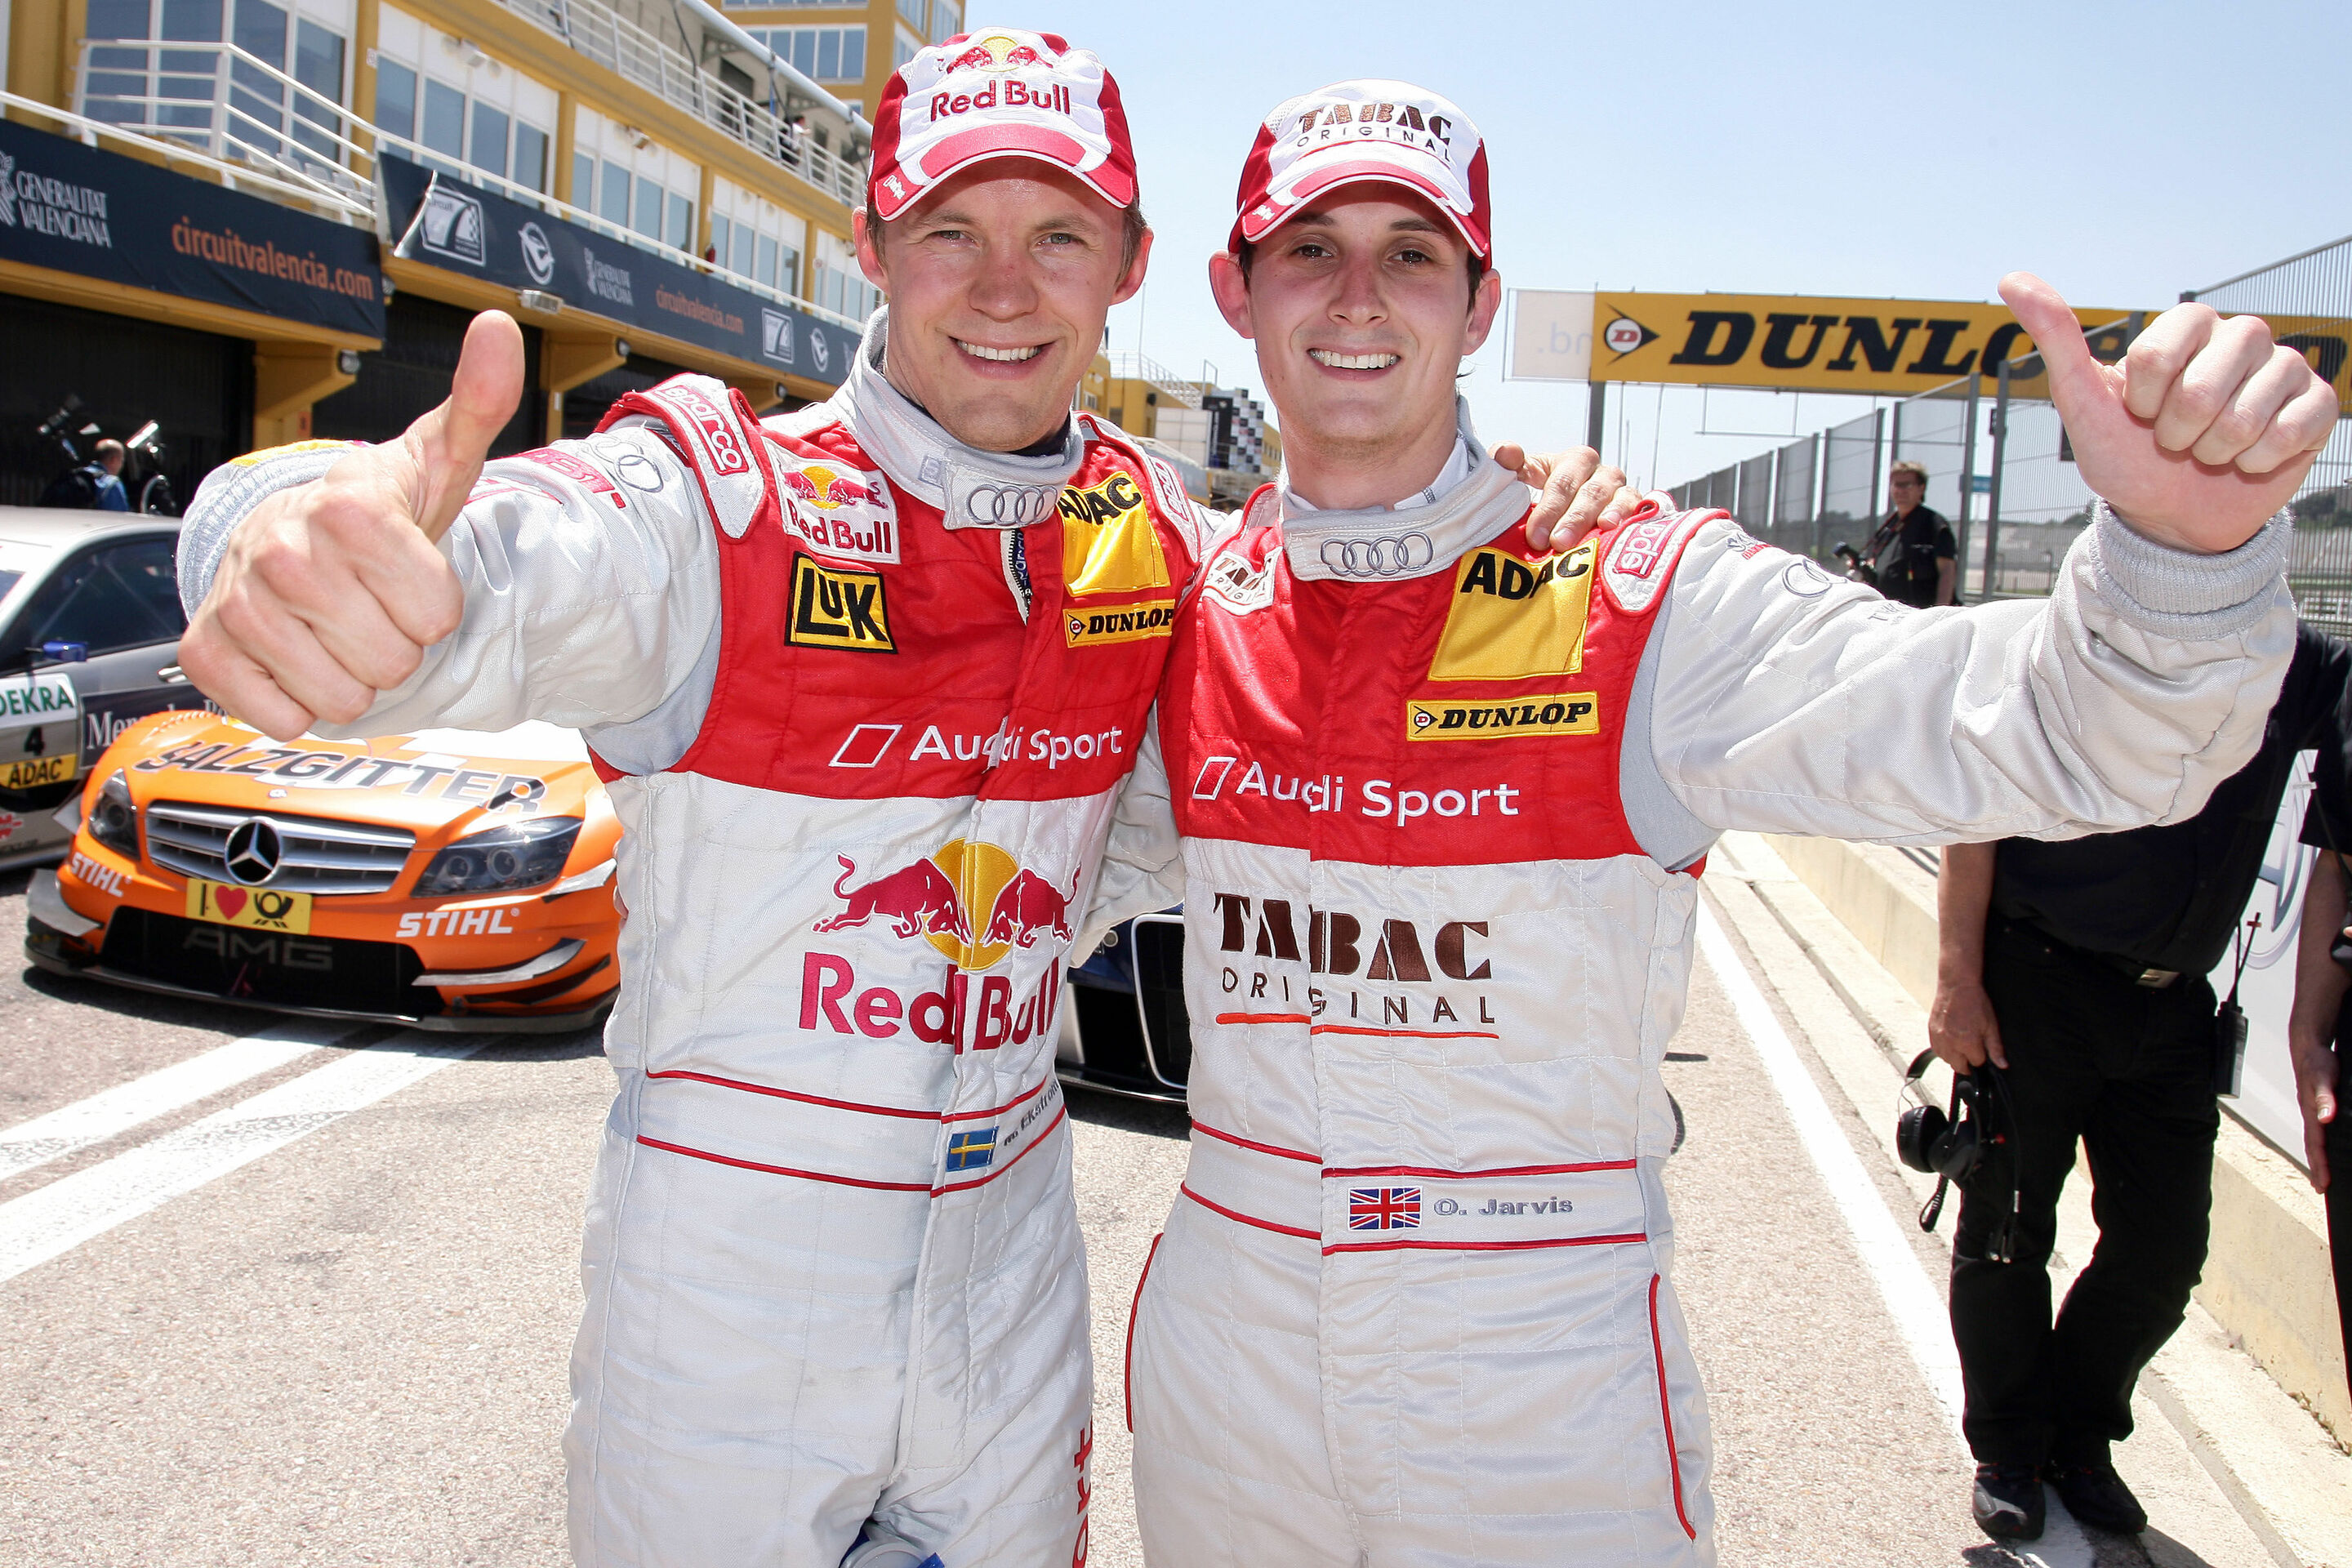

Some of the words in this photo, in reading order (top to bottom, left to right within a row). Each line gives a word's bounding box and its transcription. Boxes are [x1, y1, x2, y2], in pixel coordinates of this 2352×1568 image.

[930, 80, 996, 122] Red
[1004, 80, 1071, 115] Bull
[1298, 103, 1452, 146] TABAC
[1297, 127, 1450, 163] ORIGINAL
[16, 170, 107, 219] GENERALITAT
[19, 200, 112, 248] VALENCIANA
[172, 215, 374, 301] circuitvalencia.com
[1058, 477, 1142, 525] ADAC
[786, 499, 830, 546] Red
[831, 520, 892, 554] Bull
[1087, 608, 1174, 635] DUNLOP
[1438, 702, 1592, 730] DUNLOP
[24, 727, 45, 756] 4
[909, 716, 1025, 768] Audi
[1028, 726, 1122, 769] Sport
[7, 757, 63, 787] ADAC
[131, 740, 547, 813] SALZGITTER
[1236, 761, 1344, 813] Audi
[1362, 779, 1520, 827] Sport
[183, 926, 333, 970] AMG
[1214, 892, 1491, 982] TABAC
[799, 951, 969, 1054] Red
[973, 956, 1059, 1051] Bull
[1222, 967, 1495, 1024] ORIGINAL
[1434, 1198, 1467, 1215] O.
[1478, 1196, 1573, 1215] Jarvis
